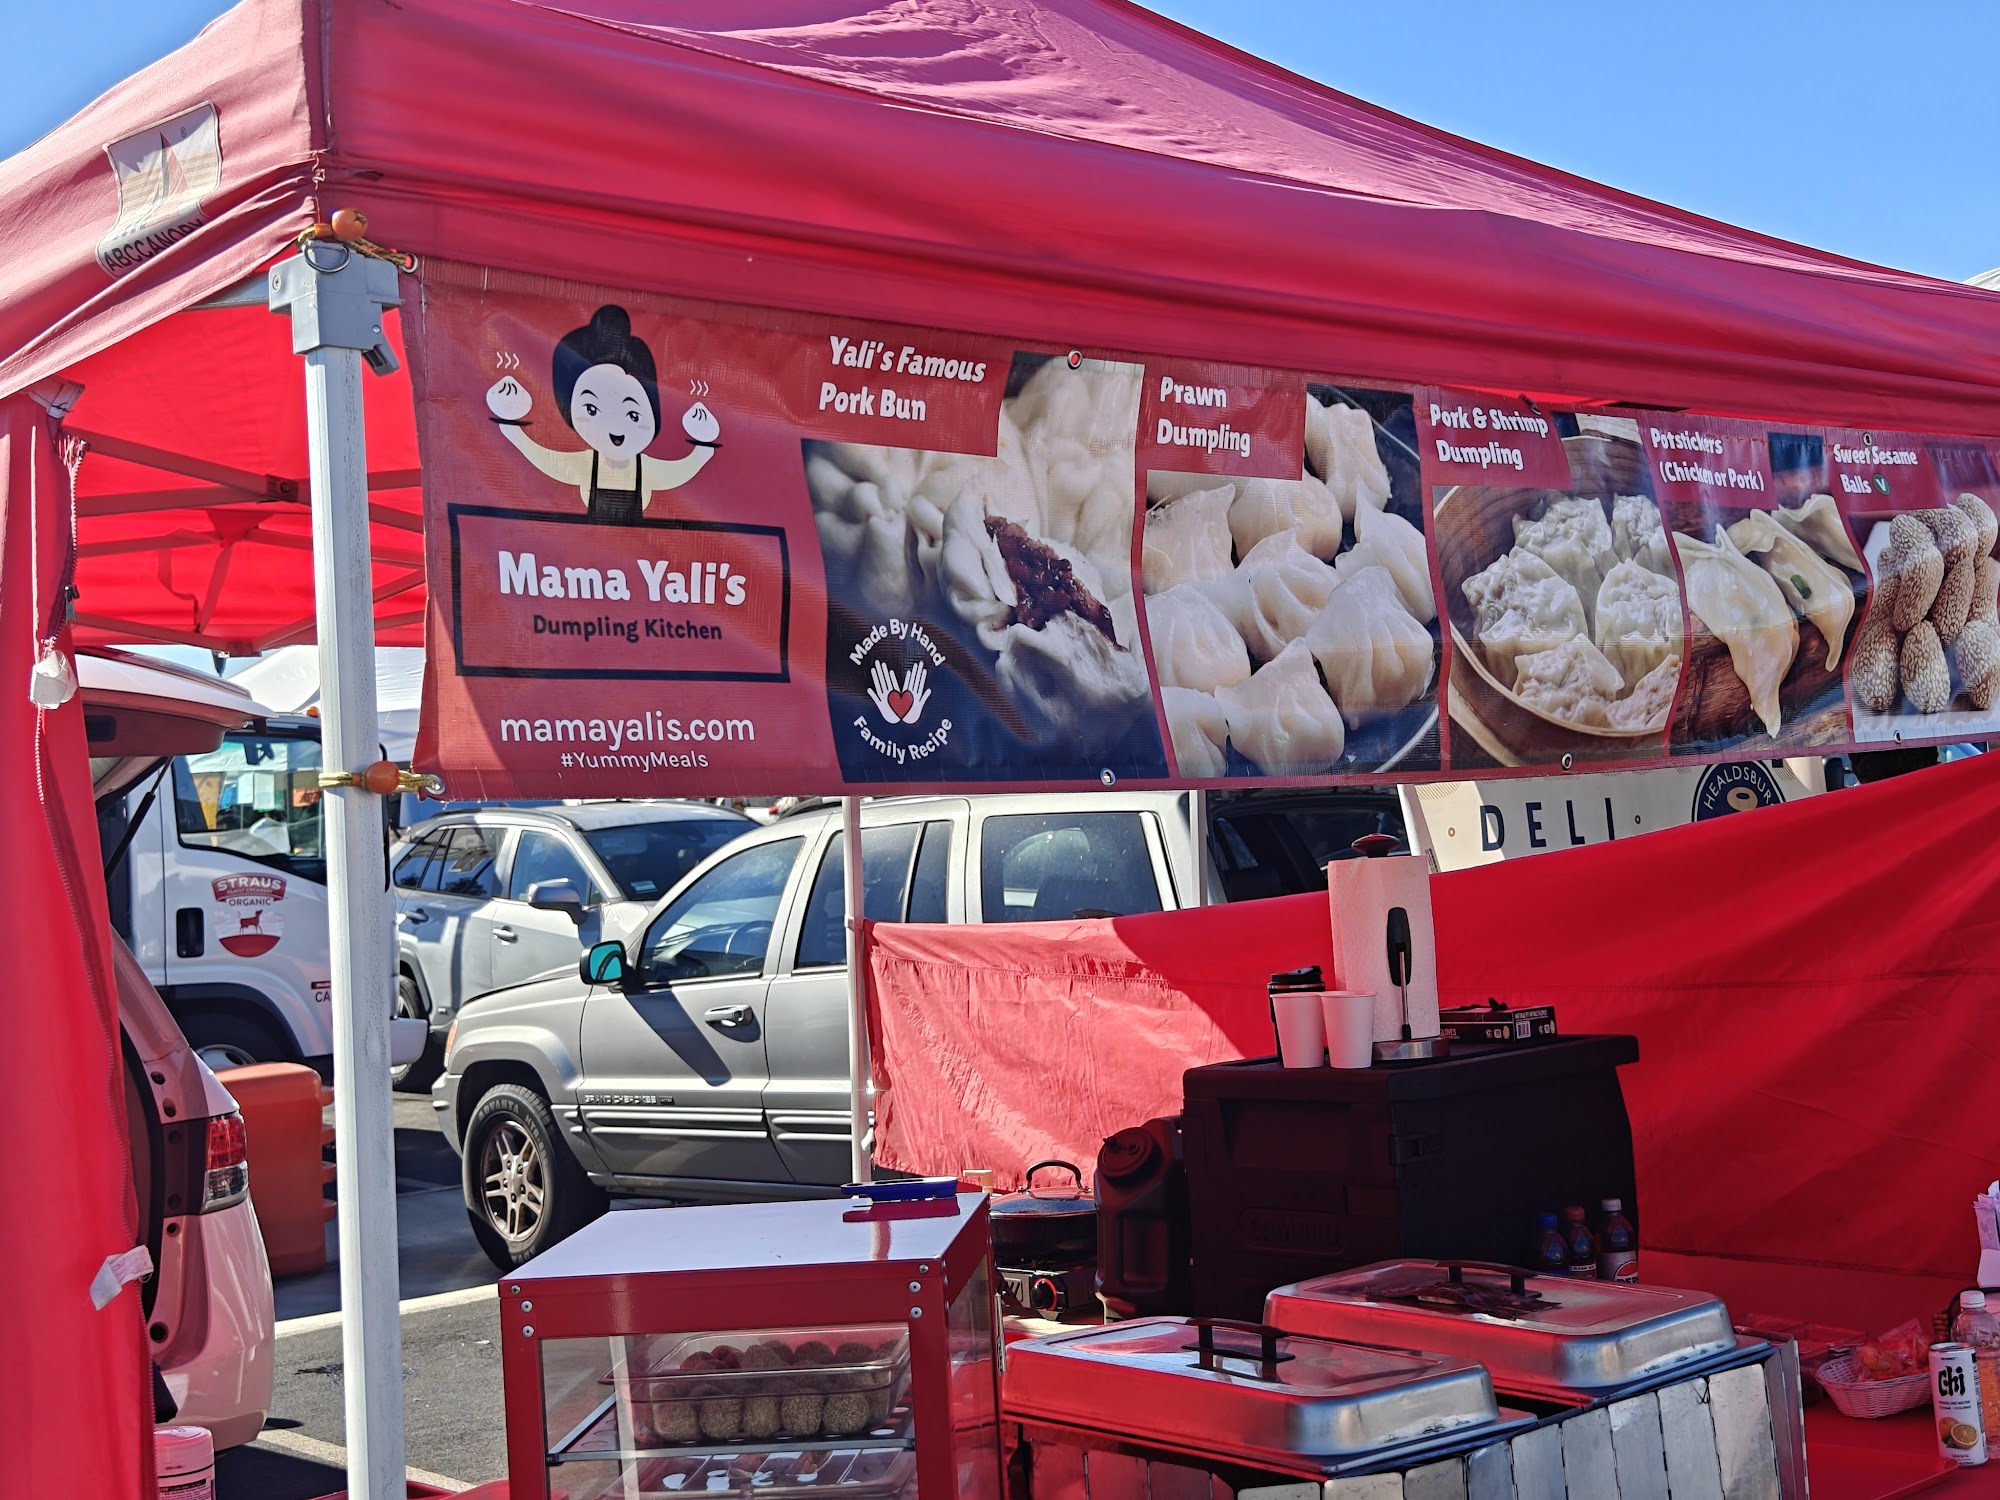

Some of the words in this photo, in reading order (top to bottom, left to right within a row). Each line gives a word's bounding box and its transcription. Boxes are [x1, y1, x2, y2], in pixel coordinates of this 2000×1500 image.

[829, 335, 895, 372] Yali's
[896, 346, 987, 382] Famous
[818, 381, 875, 416] Pork
[879, 388, 927, 421] Bun
[1160, 376, 1227, 408] Prawn
[1429, 403, 1472, 429] Pork
[1472, 407, 1487, 429] &
[1488, 408, 1549, 438] Shrimp
[1156, 418, 1251, 458] Dumpling
[1650, 427, 1723, 455] Potstickers
[1435, 439, 1524, 471] Dumpling
[1833, 443, 1871, 465] Sweet
[1871, 445, 1919, 466] Sesame
[1660, 461, 1715, 486] (Chicken
[1714, 471, 1727, 488] or
[1727, 467, 1765, 492] Pork)
[1840, 473, 1872, 494] Balls
[498, 550, 631, 601] Mama
[636, 559, 747, 606] Yali's
[533, 614, 640, 644] Dumpling
[644, 618, 722, 640] Kitchen
[849, 624, 888, 666] Made
[889, 618, 909, 640] By
[910, 622, 947, 667] Hand
[500, 710, 755, 752] mamayalis.com
[853, 715, 906, 765] Family
[908, 718, 953, 761] Recipe
[560, 750, 709, 773] #YummyMeals
[1703, 765, 1775, 811] HEALDSBUR
[1479, 797, 1616, 852] DELI
[217, 876, 282, 892] STRAUS
[228, 898, 271, 907] ORGANIC
[478, 1098, 520, 1121] ADVANTA
[1937, 1365, 1966, 1397] Chi
